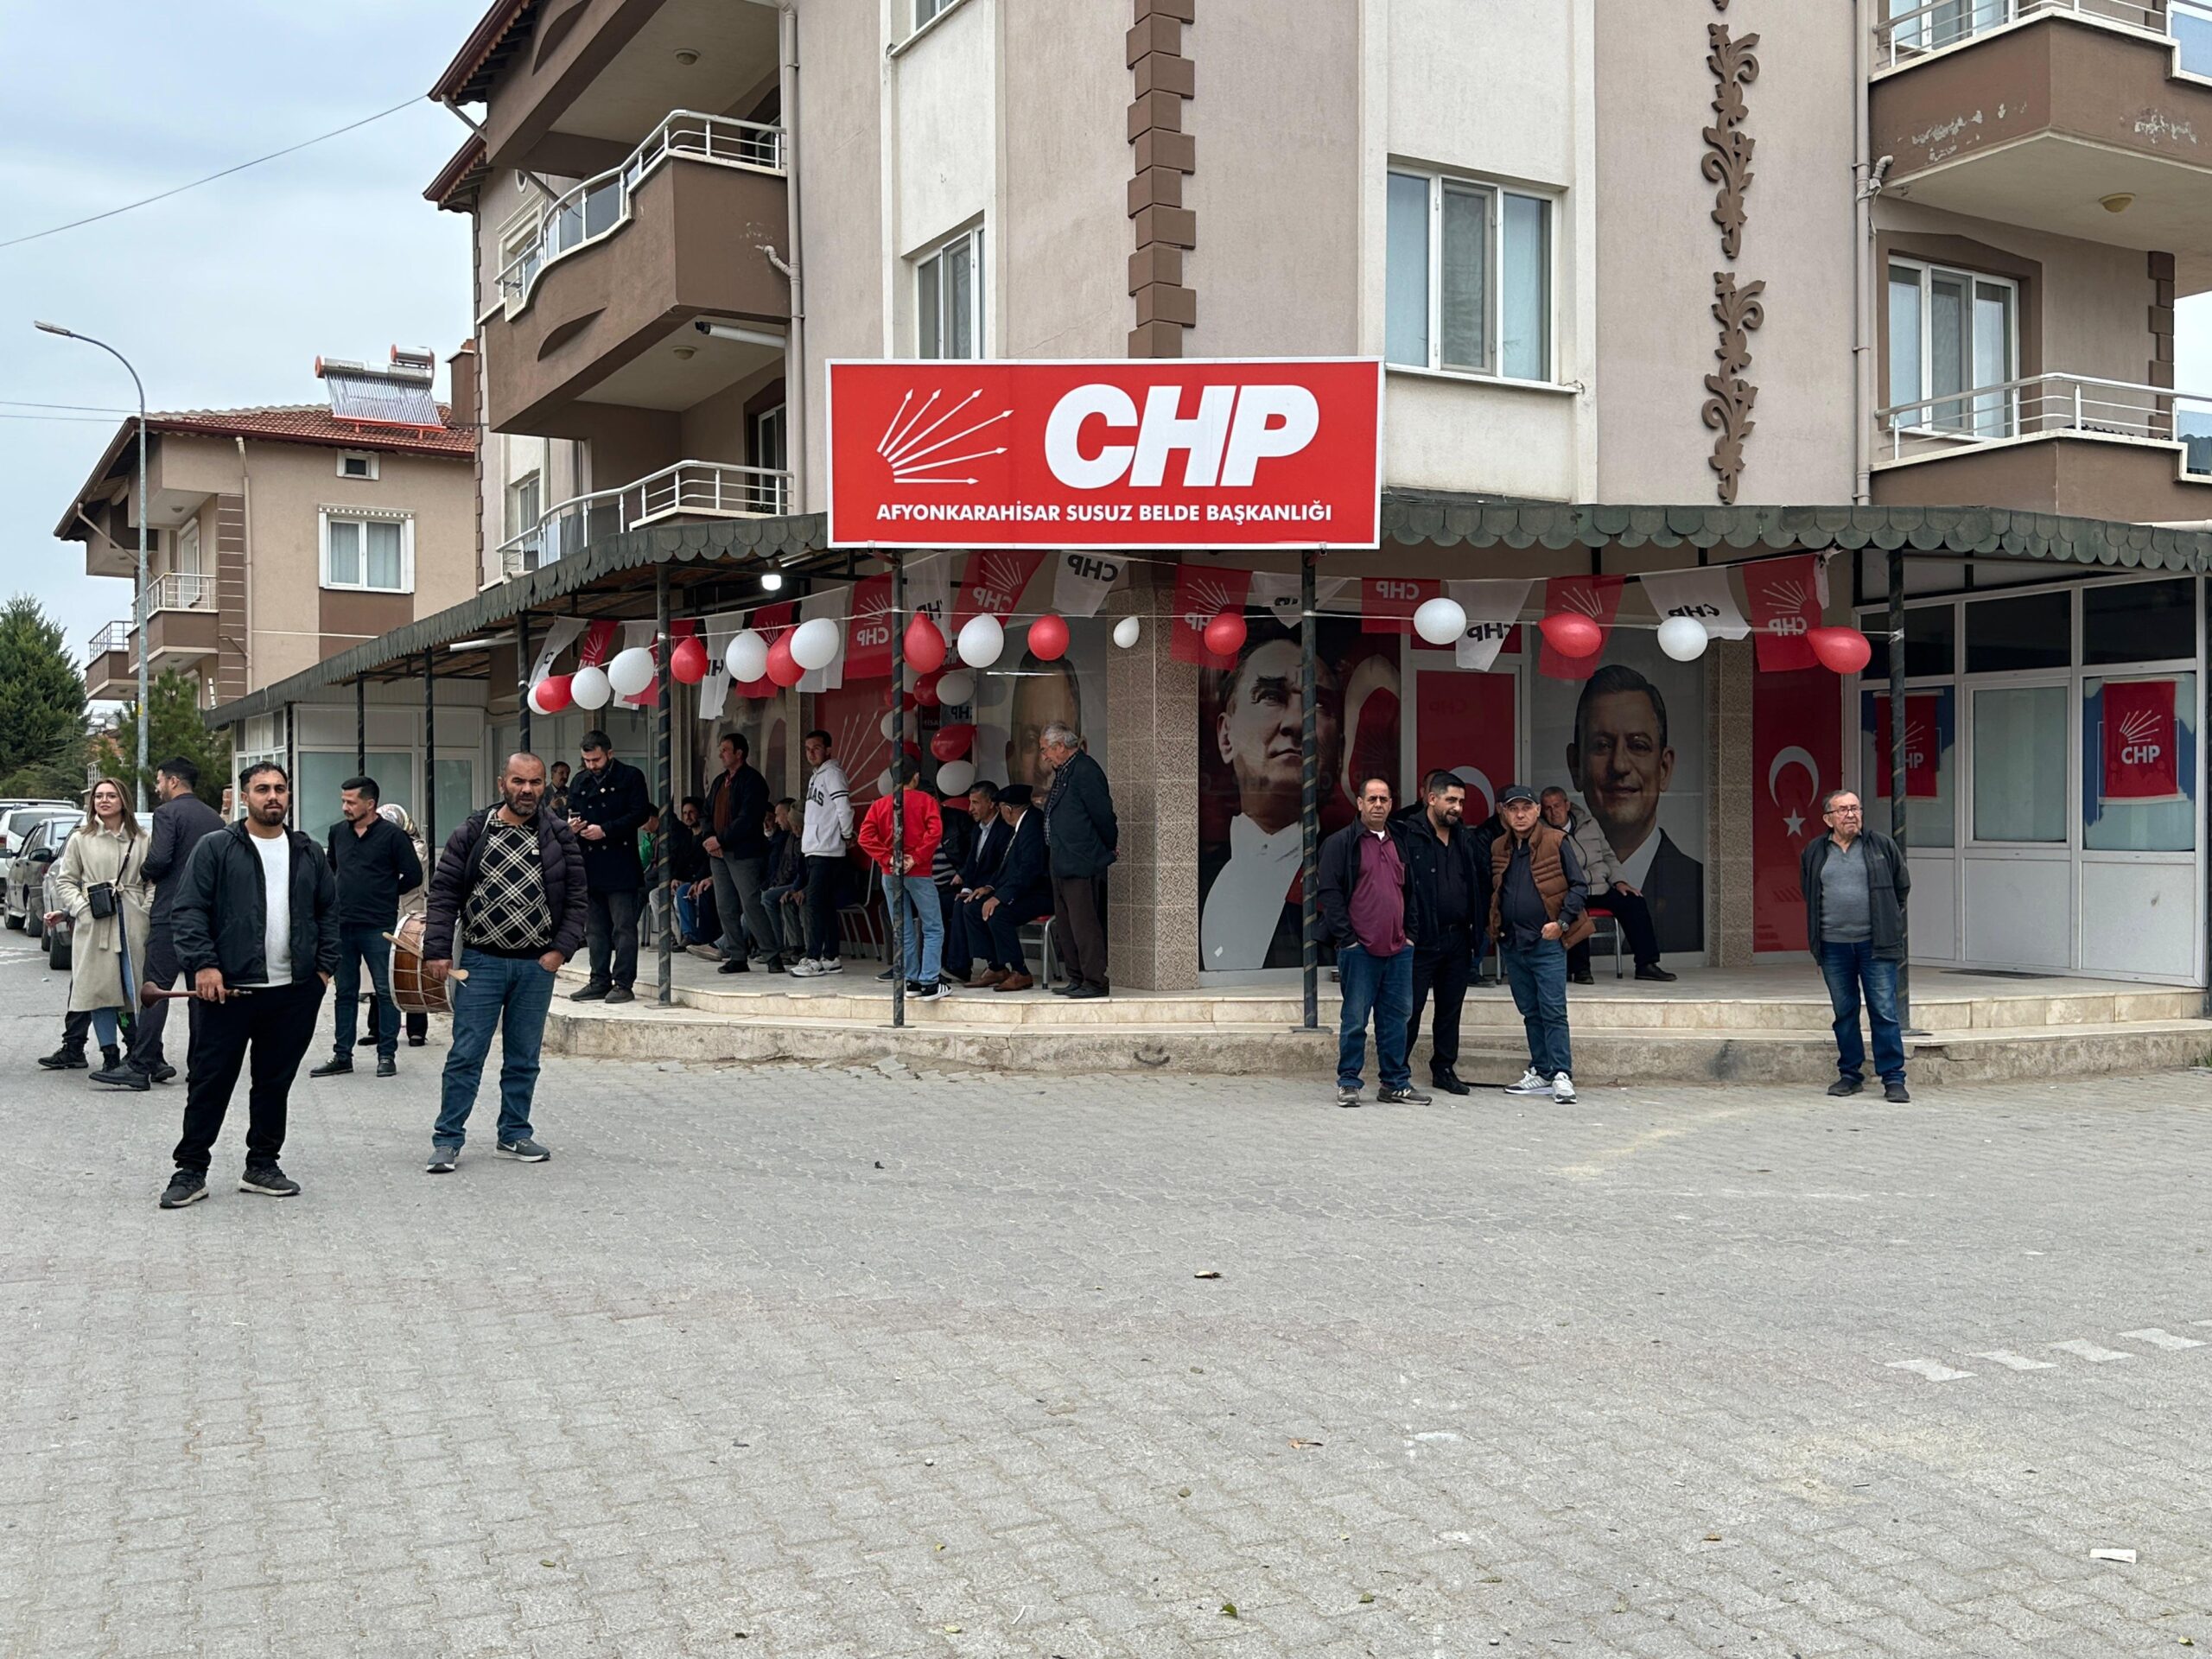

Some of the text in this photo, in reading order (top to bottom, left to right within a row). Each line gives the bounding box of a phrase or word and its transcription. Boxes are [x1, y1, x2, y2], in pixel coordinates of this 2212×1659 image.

[1045, 383, 1319, 489] CHP
[876, 499, 1332, 525] AFYONKARAHİSAR SUSUZ BELDE BAŞKANLIĞI
[2121, 745, 2160, 765] CHP
